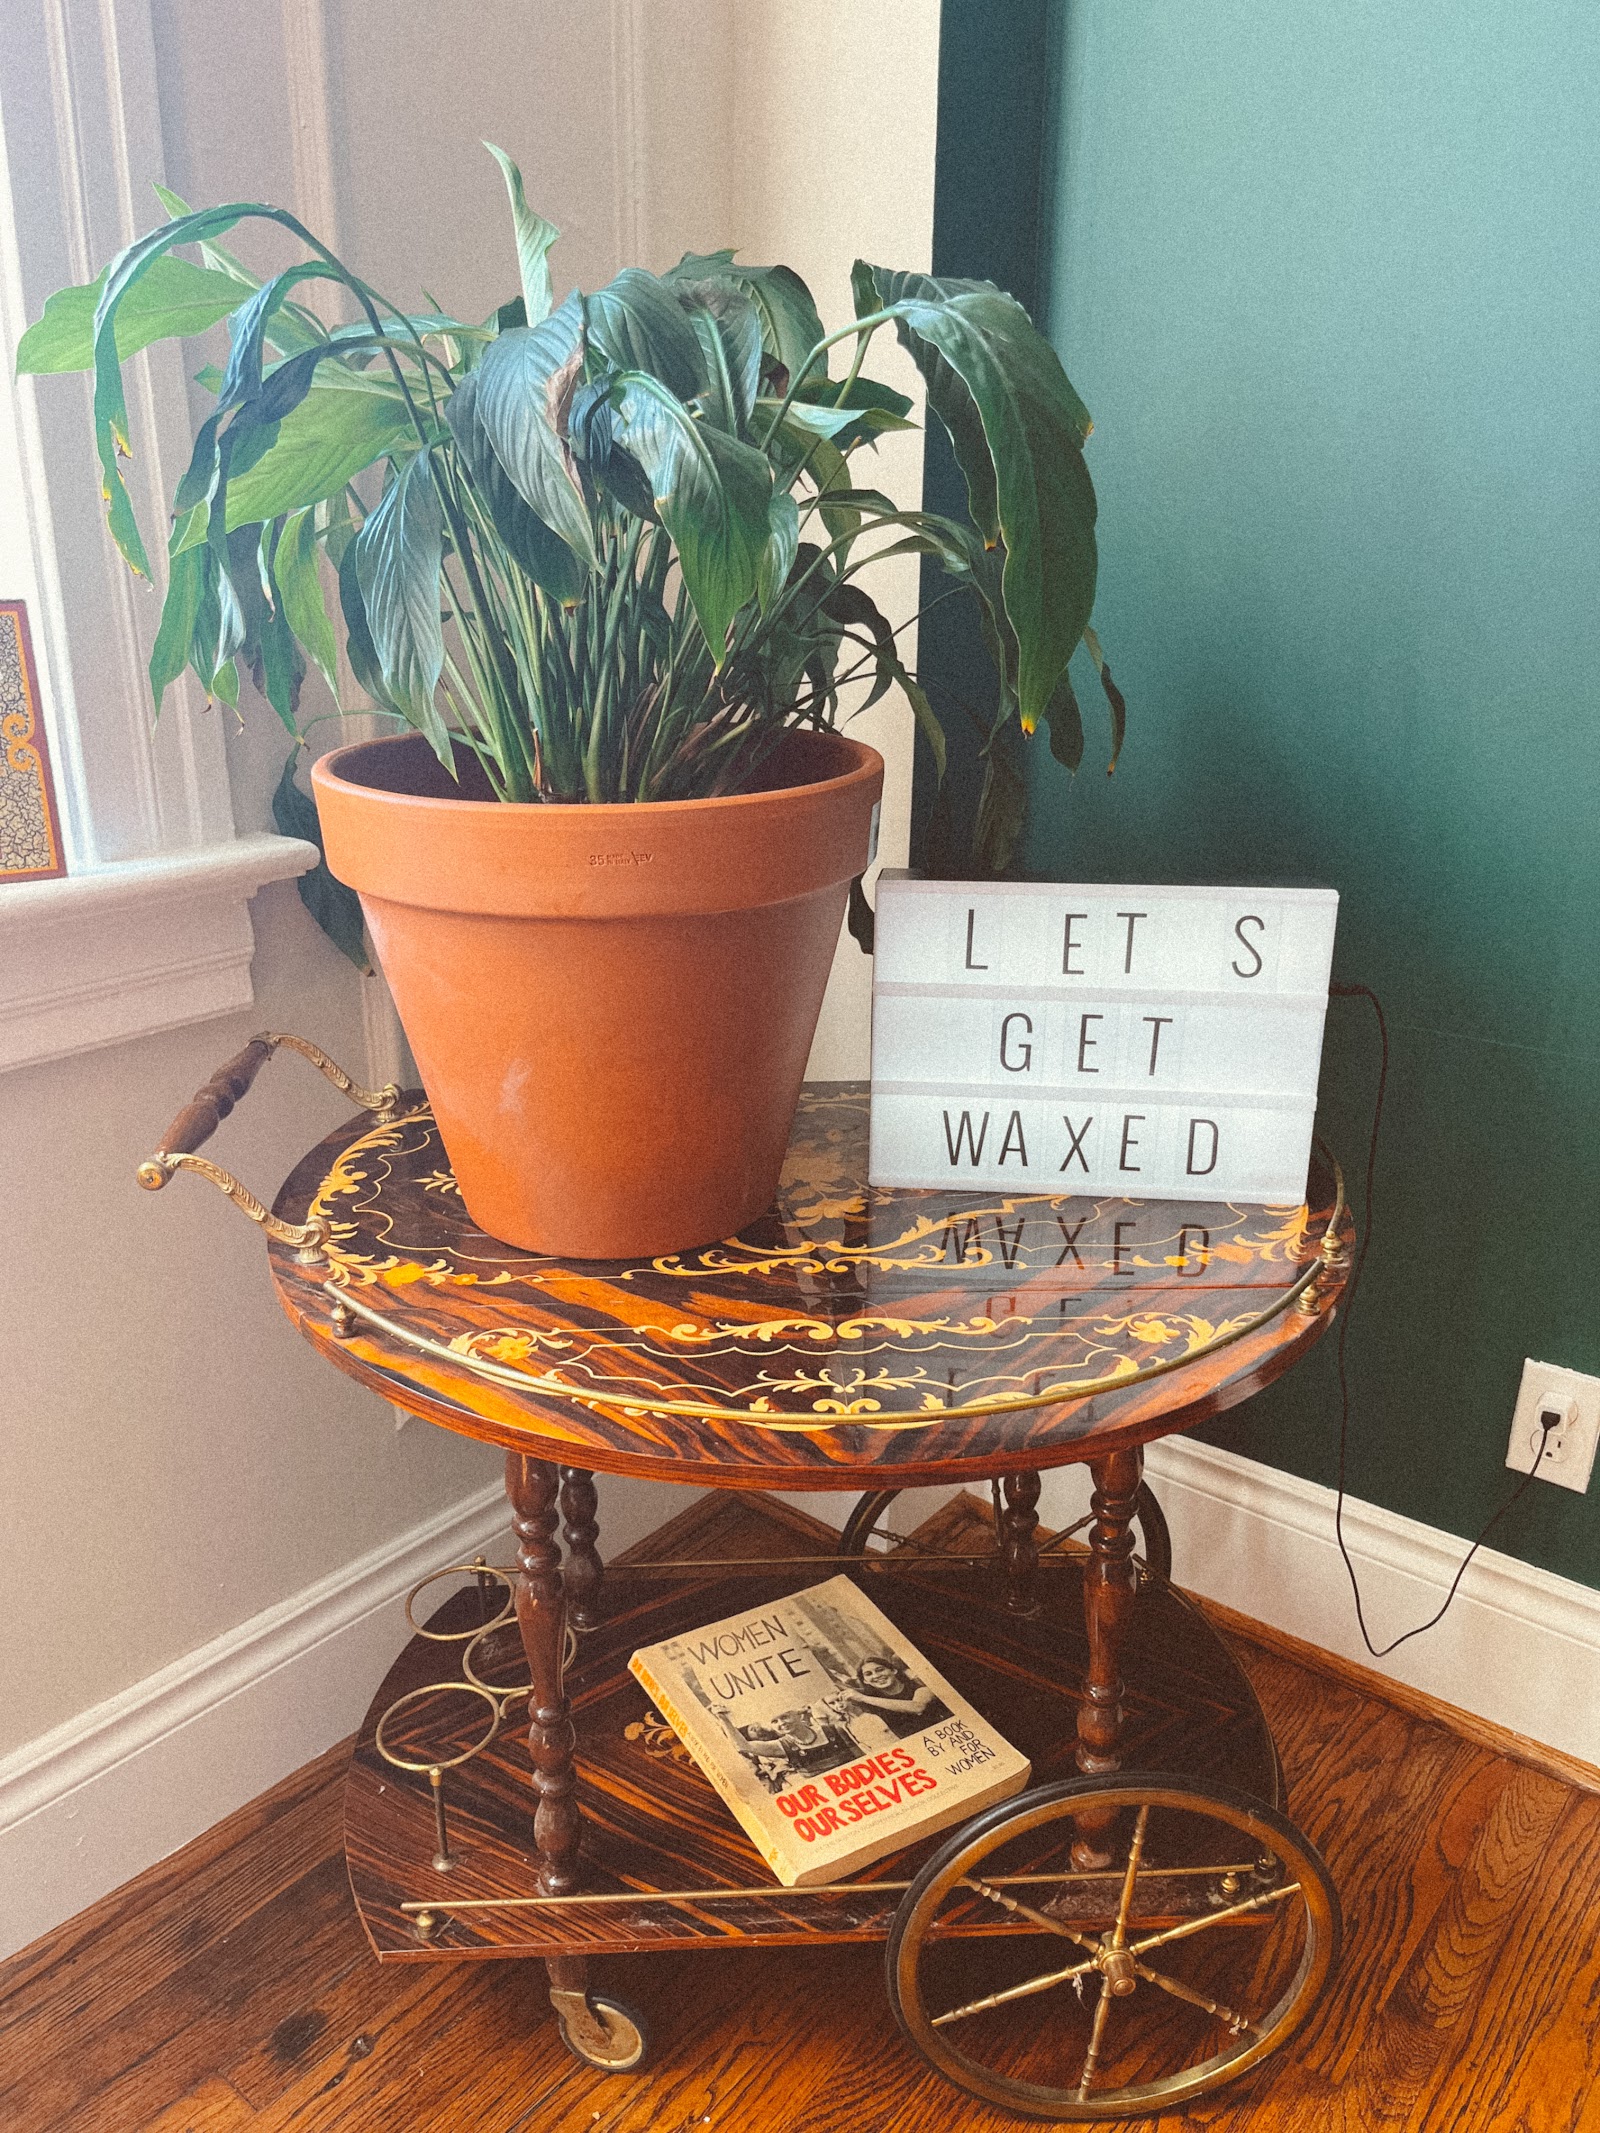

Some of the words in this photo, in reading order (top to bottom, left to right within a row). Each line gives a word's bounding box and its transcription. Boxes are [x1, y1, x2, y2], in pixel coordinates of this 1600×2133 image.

[999, 1012, 1173, 1076] GET
[942, 1110, 1219, 1176] WAXED
[687, 1615, 788, 1665] WOMEN
[710, 1648, 811, 1700] UNITE
[923, 1736, 935, 1747] A
[934, 1719, 968, 1740] BOOK
[927, 1742, 946, 1757] BY
[949, 1730, 975, 1747] AND
[959, 1739, 986, 1755] FOR
[776, 1784, 830, 1818] OUR
[823, 1748, 915, 1797] BODIES
[945, 1747, 996, 1775] WOMEN
